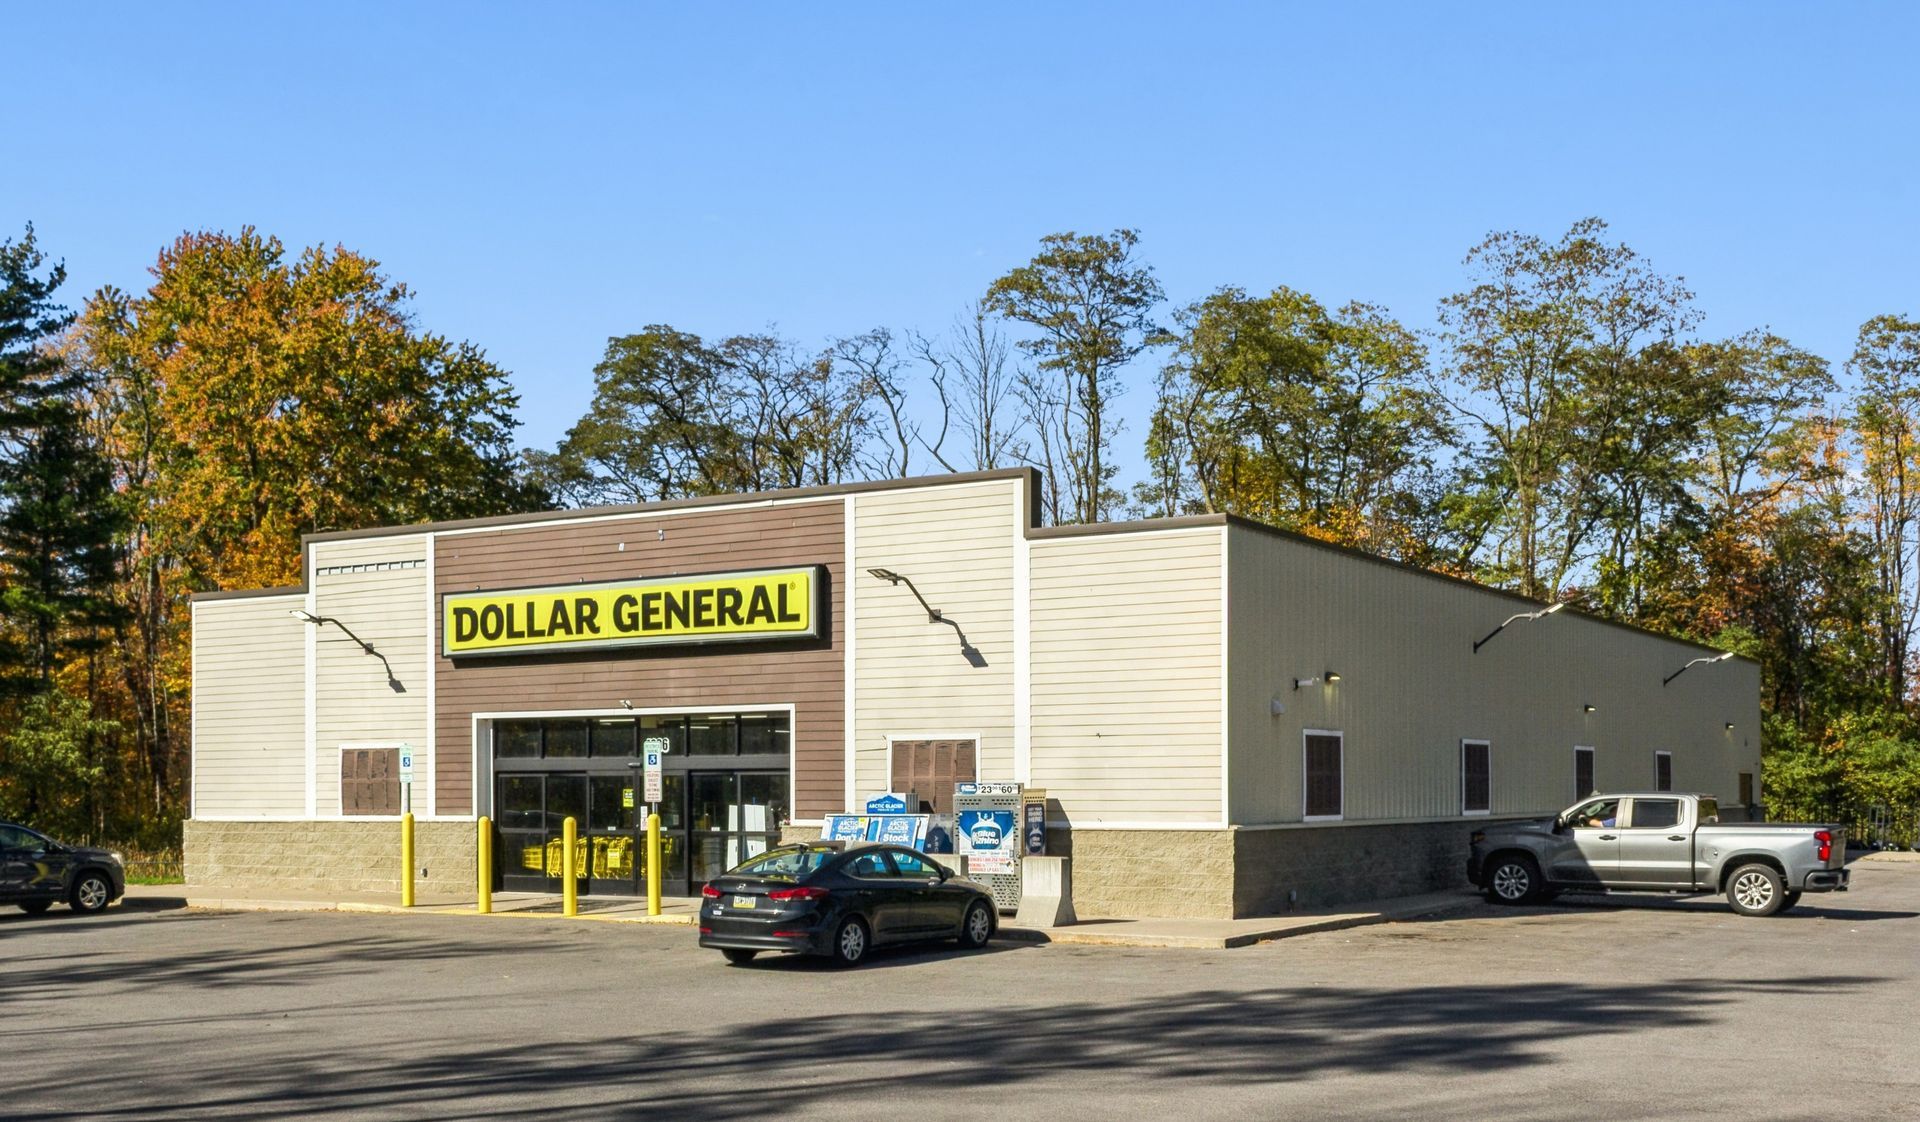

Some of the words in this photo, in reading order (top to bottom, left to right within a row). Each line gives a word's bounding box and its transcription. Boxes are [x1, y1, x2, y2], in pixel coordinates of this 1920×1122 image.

[453, 597, 601, 643] DOLLAR
[612, 583, 801, 633] GENERAL
[882, 833, 909, 842] Stock
